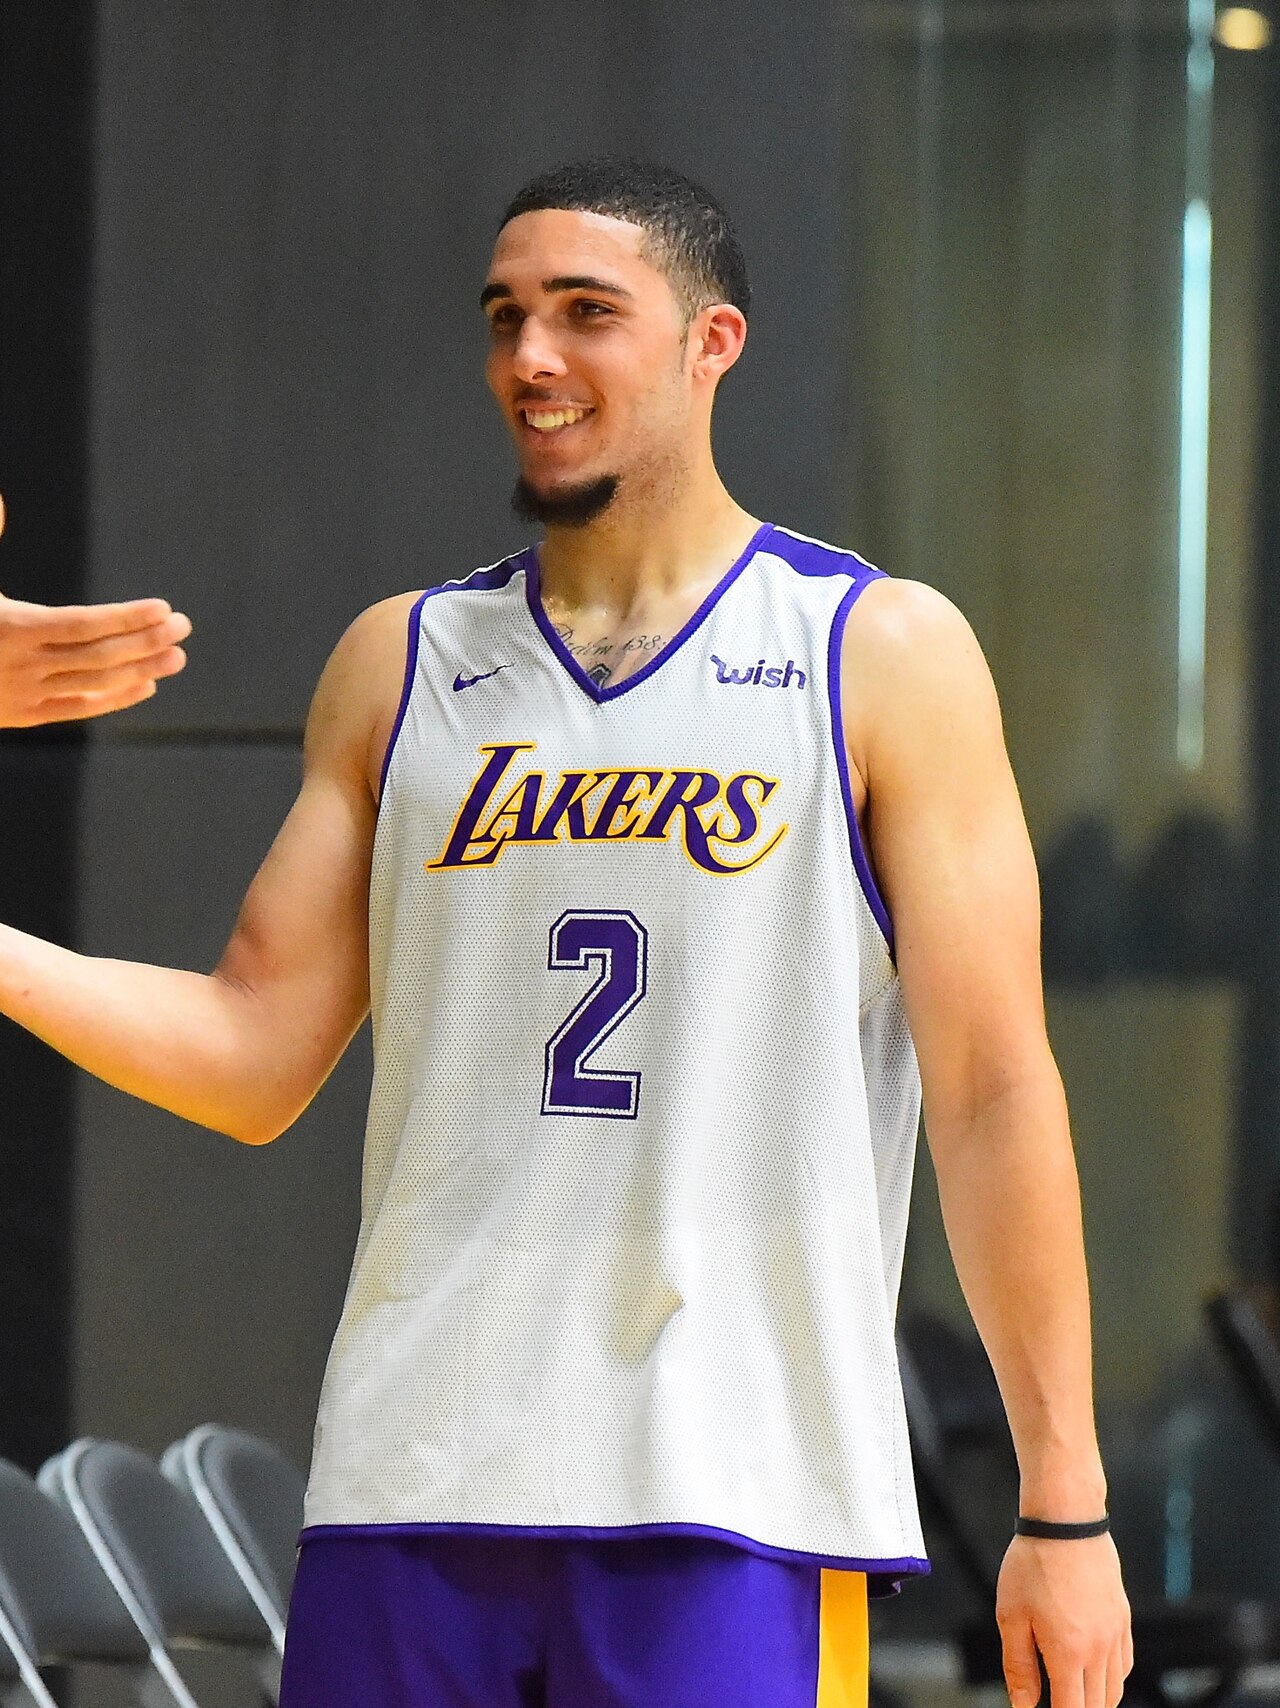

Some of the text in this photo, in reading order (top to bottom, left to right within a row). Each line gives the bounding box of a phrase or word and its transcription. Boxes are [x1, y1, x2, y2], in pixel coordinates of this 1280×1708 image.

[710, 655, 806, 689] wish
[424, 742, 789, 877] LAKERS
[540, 909, 649, 1120] 2
